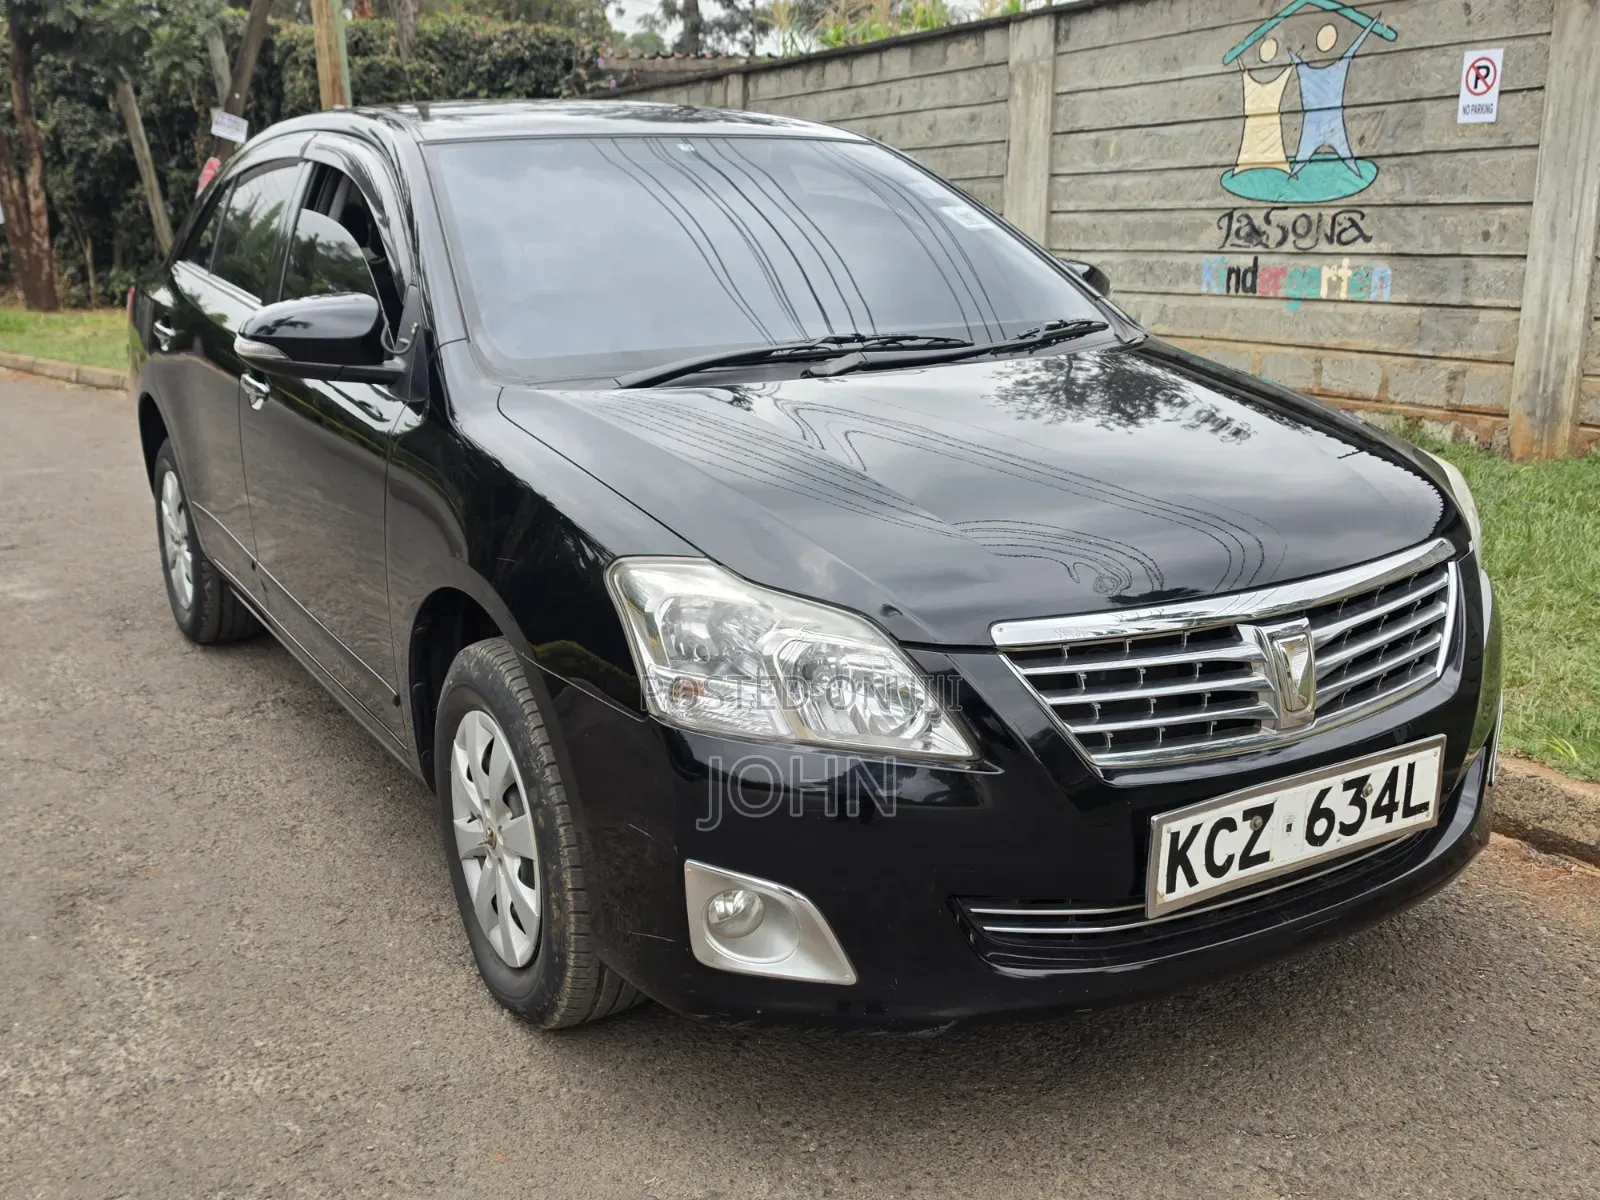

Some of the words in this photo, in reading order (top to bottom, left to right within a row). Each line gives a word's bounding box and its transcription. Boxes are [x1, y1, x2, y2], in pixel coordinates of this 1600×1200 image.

[1462, 104, 1470, 115] NO
[1471, 103, 1493, 115] PARKING
[1201, 255, 1392, 311] Kindergarten
[1166, 802, 1276, 894] KCZ
[1305, 761, 1431, 847] 634L
